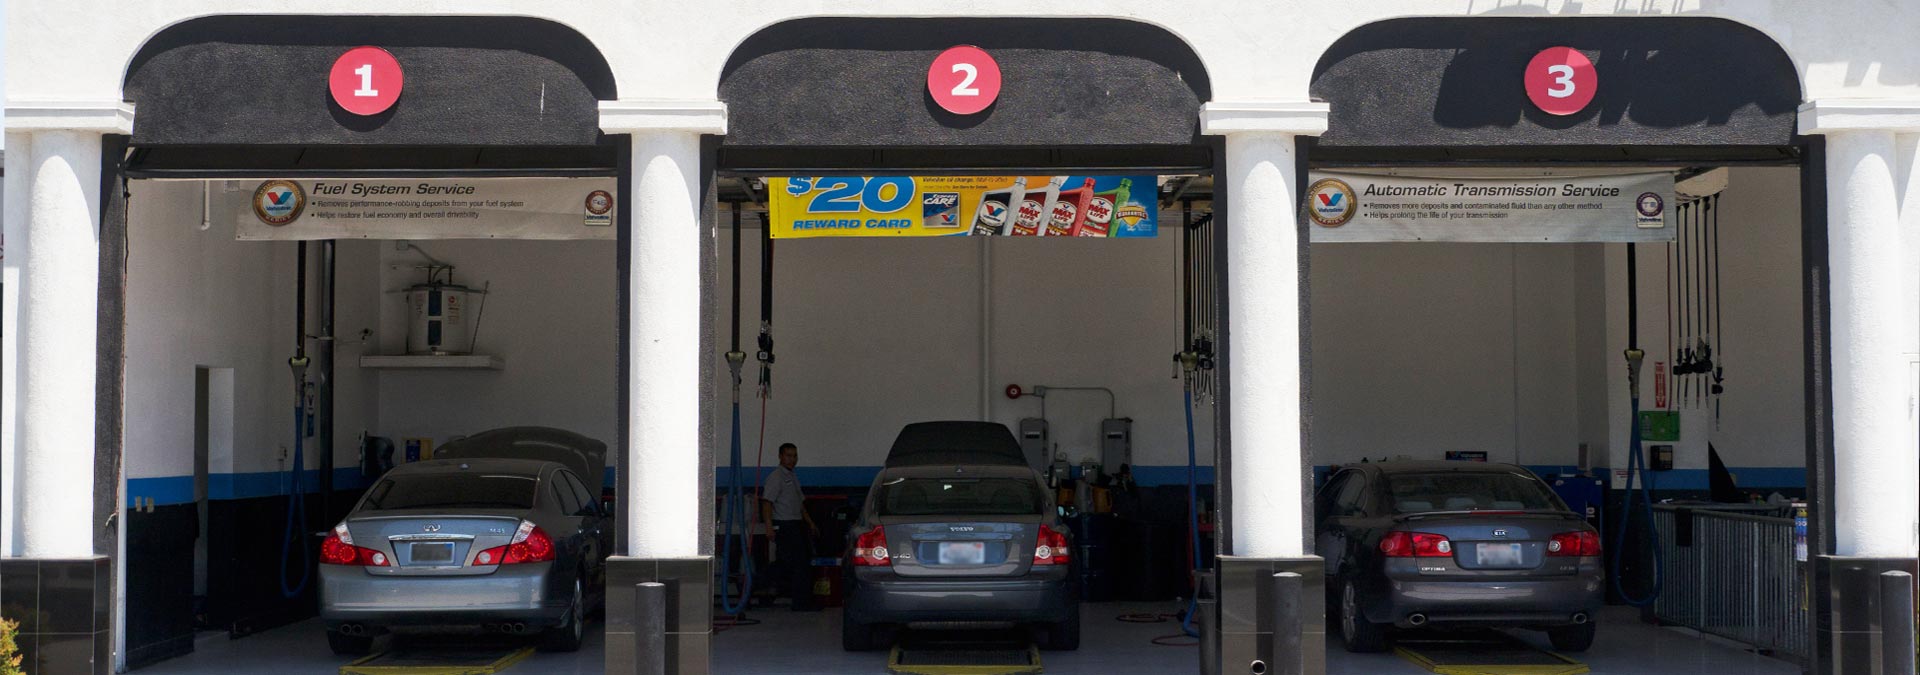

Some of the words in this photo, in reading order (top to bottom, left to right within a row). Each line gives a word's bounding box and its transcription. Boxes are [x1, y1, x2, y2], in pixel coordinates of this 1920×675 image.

[354, 64, 378, 97] 1
[951, 63, 980, 96] 2
[1547, 65, 1575, 98] 3
[312, 183, 348, 195] Fuel
[352, 183, 411, 197] System
[416, 183, 475, 195] Service
[786, 176, 916, 213] $20
[1364, 183, 1447, 196] Automatic
[1454, 183, 1556, 197] Transmission
[1562, 184, 1620, 197] Service
[350, 200, 420, 209] performance-robbing
[422, 200, 450, 209] deposits
[469, 201, 484, 209] your
[500, 200, 524, 209] system
[1369, 202, 1400, 210] Removes
[1420, 202, 1448, 211] deposits
[1450, 202, 1463, 210] and
[1464, 202, 1510, 210] contaminated
[1511, 202, 1526, 210] fluid
[1527, 202, 1542, 210] than
[1543, 203, 1556, 211] any
[1557, 202, 1576, 210] other
[1577, 202, 1602, 210] method
[317, 211, 336, 220] Helps
[363, 211, 375, 219] fuel
[377, 212, 407, 220] economy
[409, 211, 422, 219] and
[423, 211, 445, 219] overall
[447, 211, 479, 220] drivability
[1019, 207, 1040, 218] MAX
[1369, 212, 1388, 220] Helps
[1390, 212, 1415, 221] prolong
[1449, 213, 1465, 221] your
[793, 219, 861, 230] REWARD
[865, 219, 912, 229] CARD
